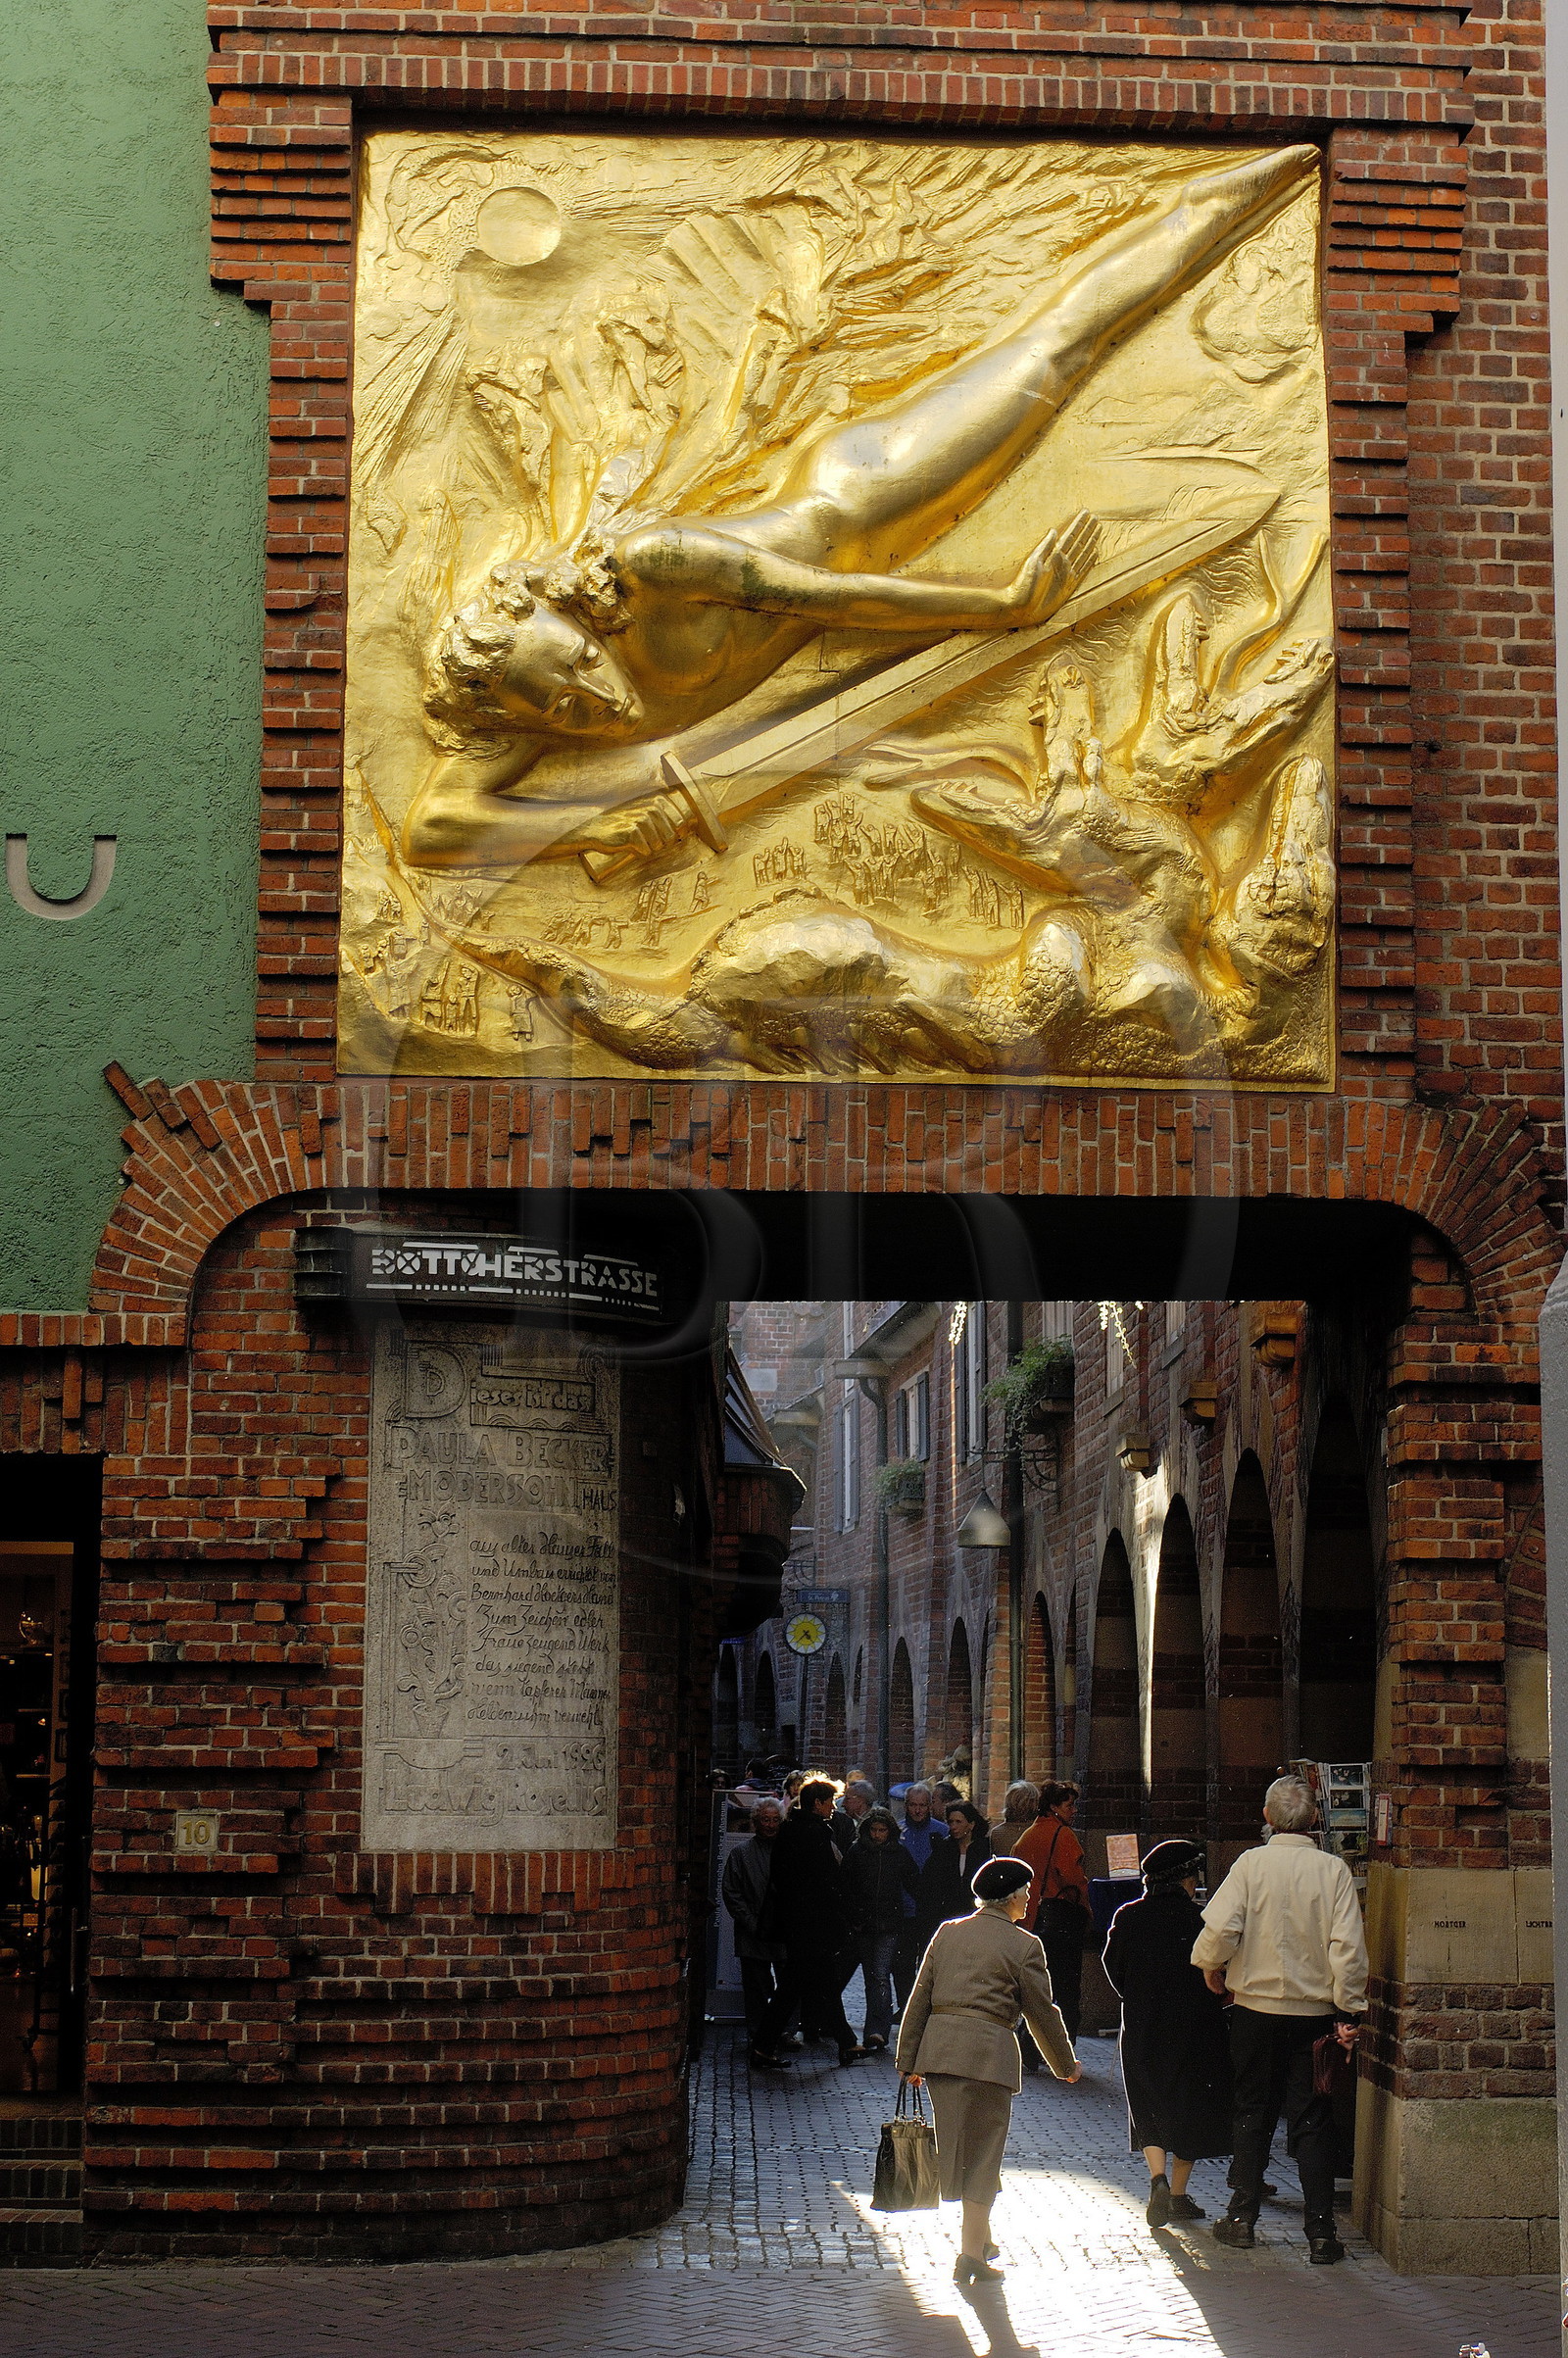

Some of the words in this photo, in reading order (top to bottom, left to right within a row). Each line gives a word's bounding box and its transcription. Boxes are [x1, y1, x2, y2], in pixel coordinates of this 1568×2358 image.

[371, 1248, 659, 1298] BÖTTCHERSTRASSE
[386, 1425, 497, 1471] PAULA
[508, 1429, 609, 1472] BECKER
[582, 1487, 617, 1511] HAUS
[471, 1558, 501, 1578] und
[503, 1558, 555, 1580] Umbau
[470, 1582, 533, 1603] Bernhard
[573, 1606, 605, 1630] edler
[578, 1629, 611, 1653] Werk
[180, 1820, 211, 1845] 10
[712, 1906, 722, 1928] Paula
